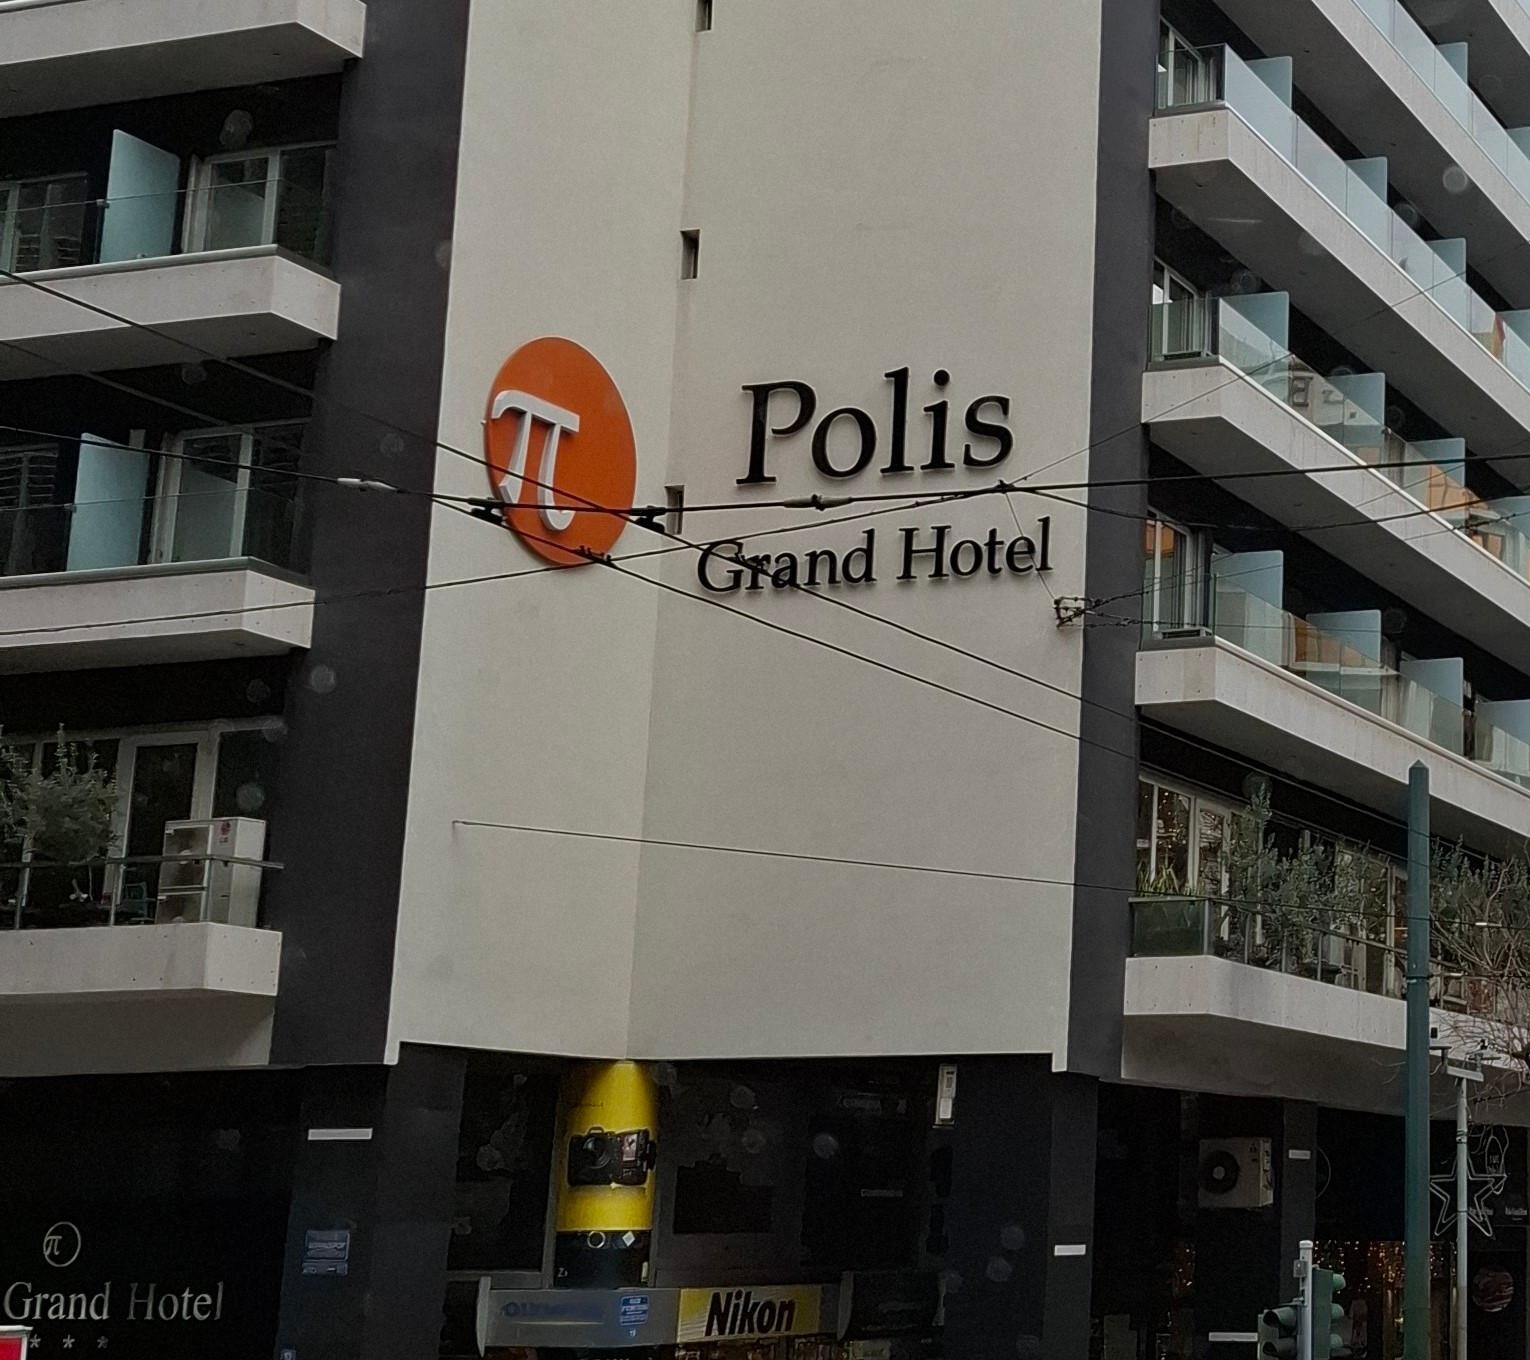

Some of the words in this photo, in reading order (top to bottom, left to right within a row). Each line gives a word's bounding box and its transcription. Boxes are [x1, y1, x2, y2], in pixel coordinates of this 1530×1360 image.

[736, 366, 1014, 485] Polis
[697, 527, 878, 592] Grand
[896, 515, 1054, 582] Hotel
[3, 1281, 112, 1320] Grand
[126, 1280, 225, 1320] Hotel
[704, 1288, 797, 1337] Nikon
